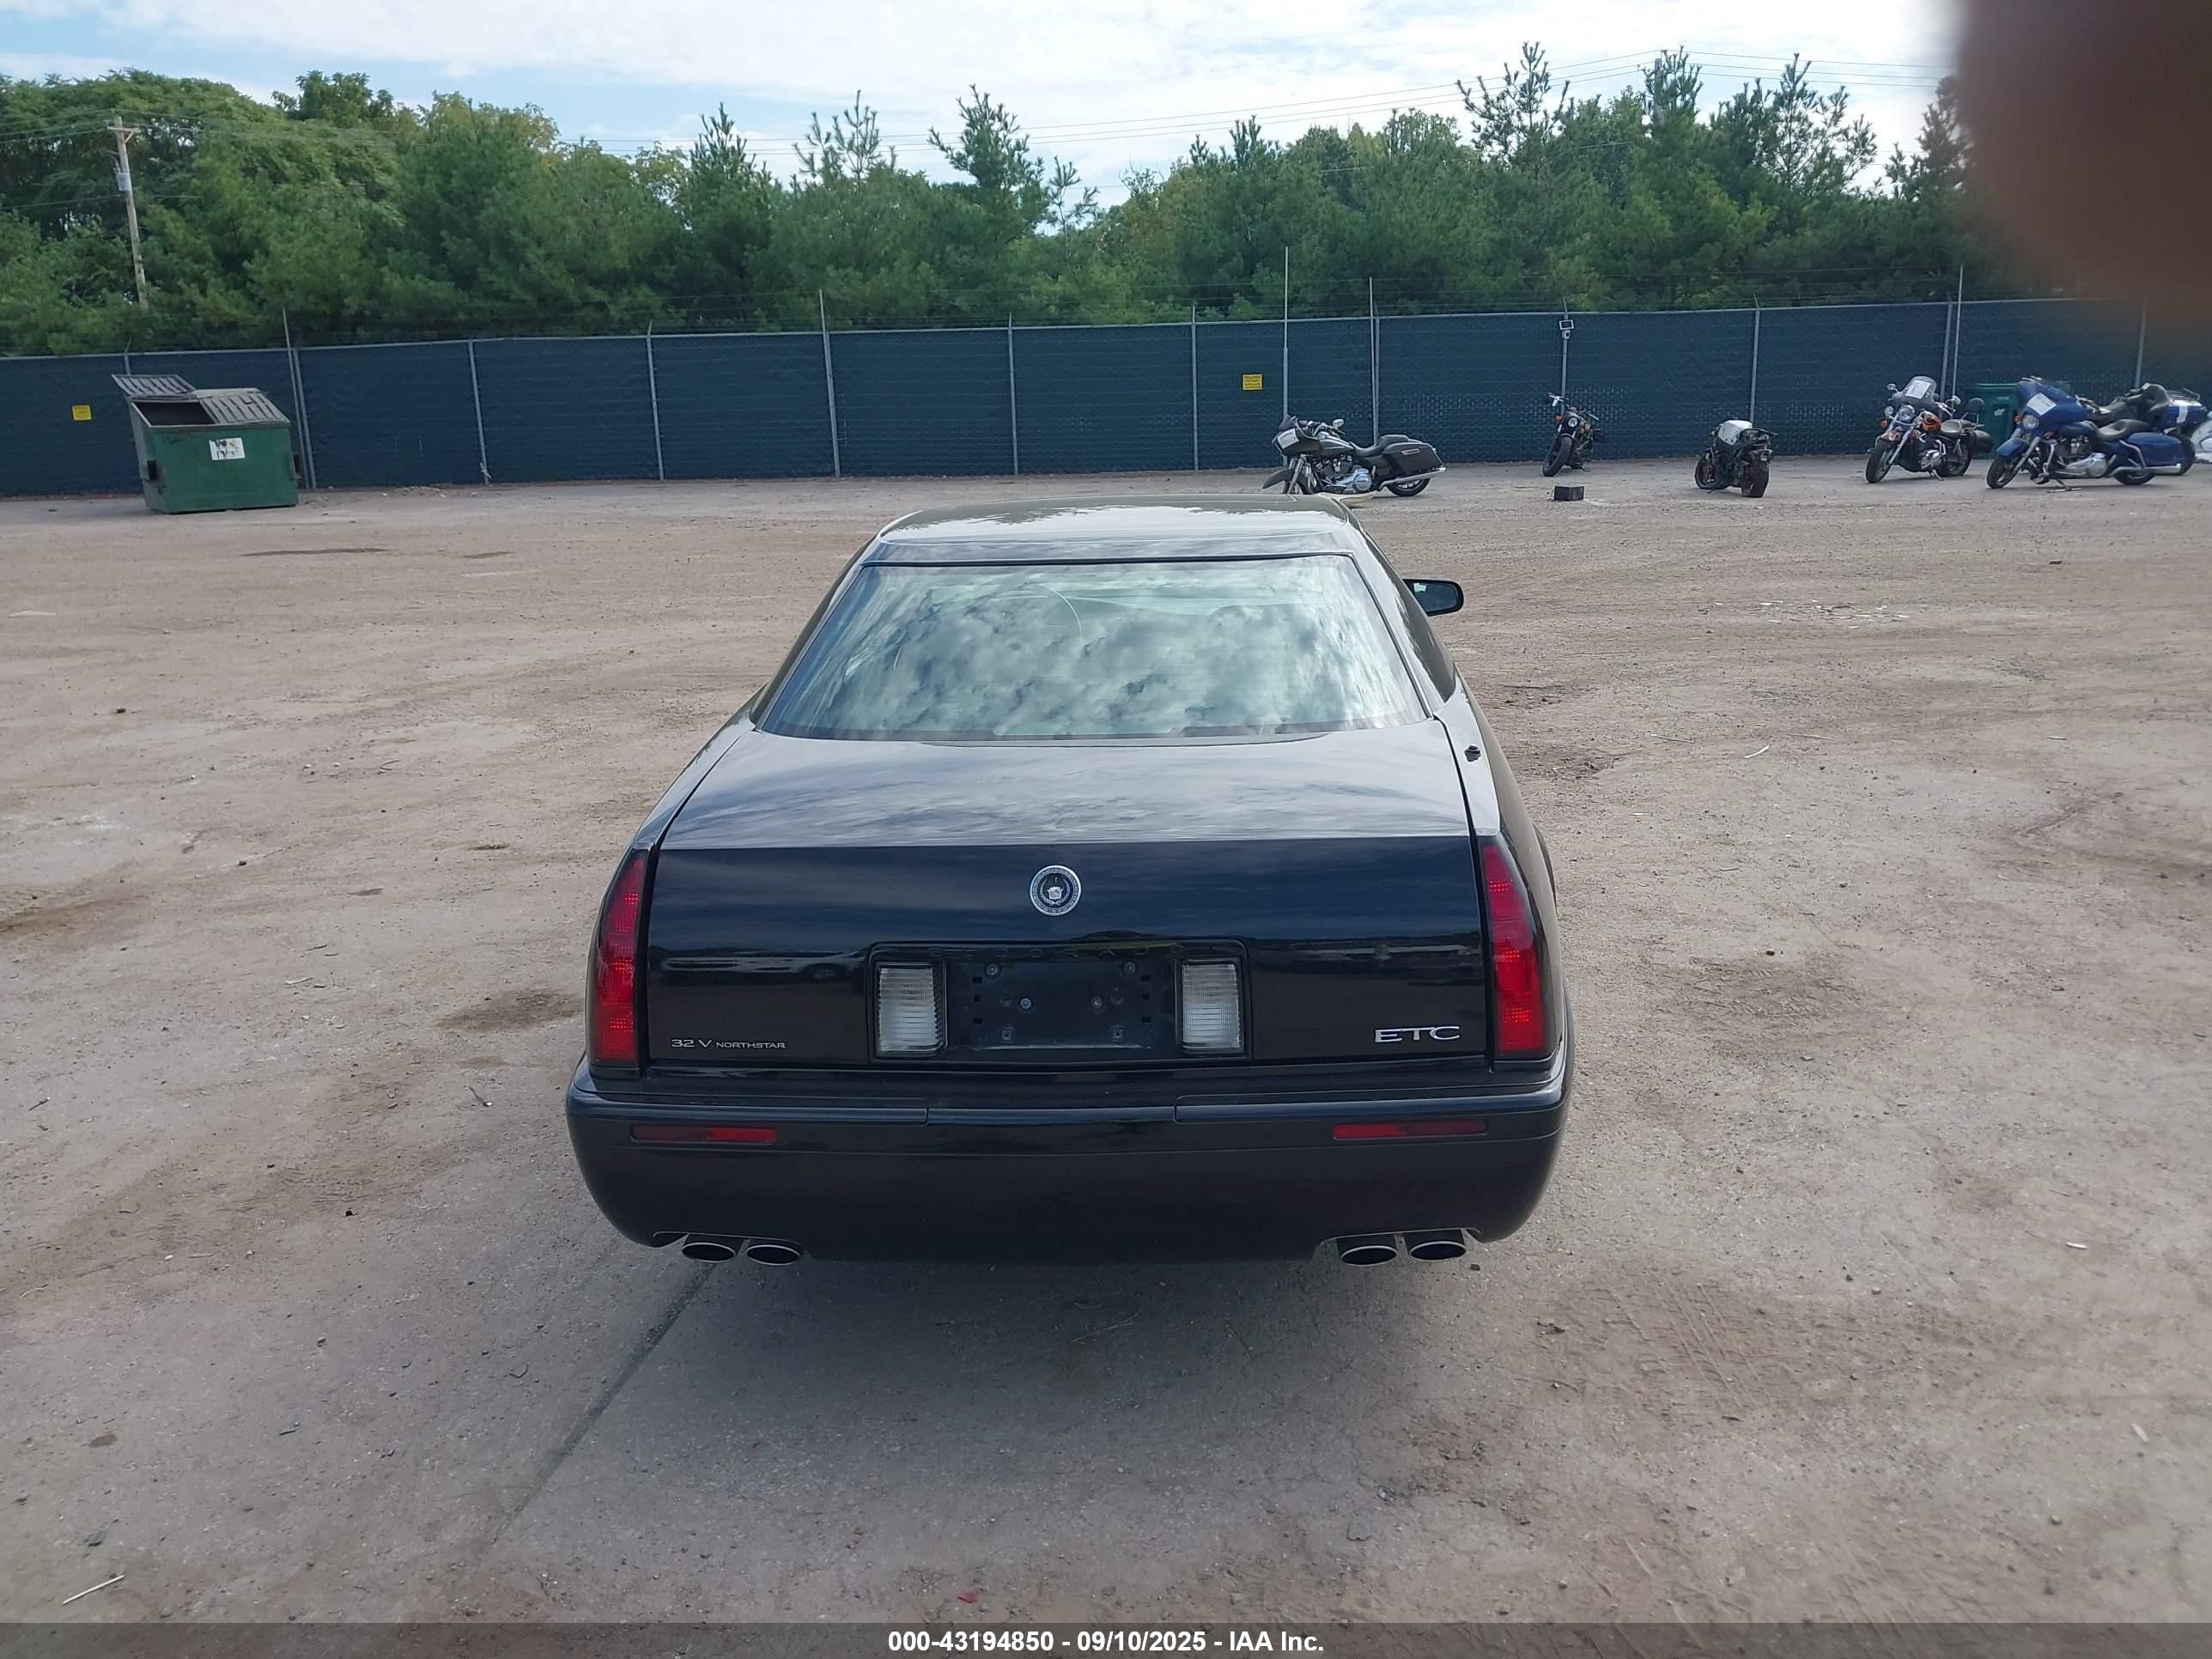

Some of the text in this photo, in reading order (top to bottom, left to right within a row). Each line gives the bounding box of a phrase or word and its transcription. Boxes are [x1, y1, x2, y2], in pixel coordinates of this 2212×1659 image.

[1375, 1025, 1460, 1042] ETC
[672, 1039, 695, 1048] 32
[697, 1039, 713, 1048] V
